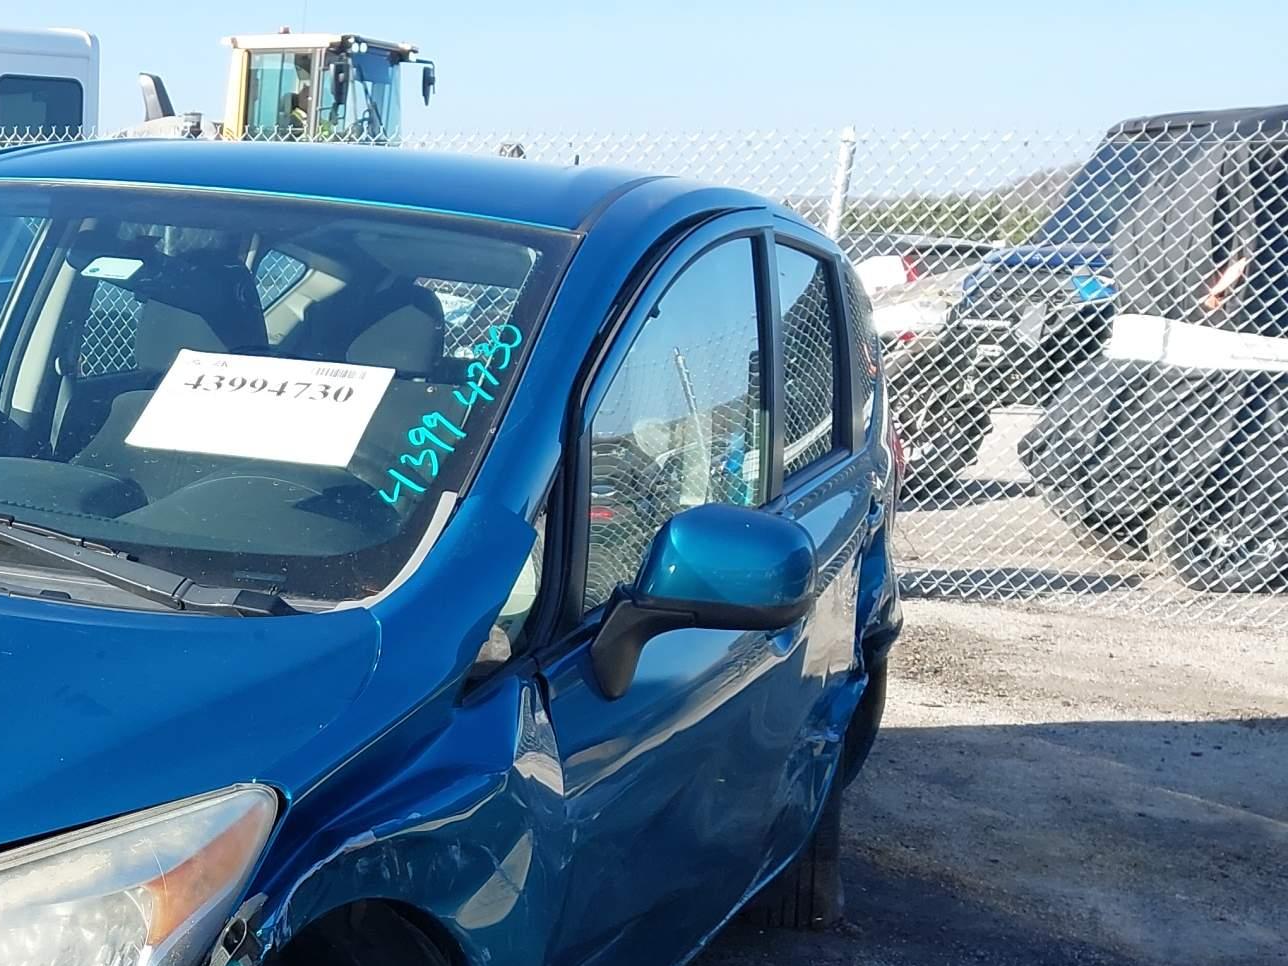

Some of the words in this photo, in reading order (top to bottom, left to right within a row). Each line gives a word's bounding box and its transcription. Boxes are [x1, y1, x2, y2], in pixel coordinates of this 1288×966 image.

[183, 373, 355, 403] 43994730
[378, 411, 468, 504] 4399
[452, 324, 523, 406] 4730
